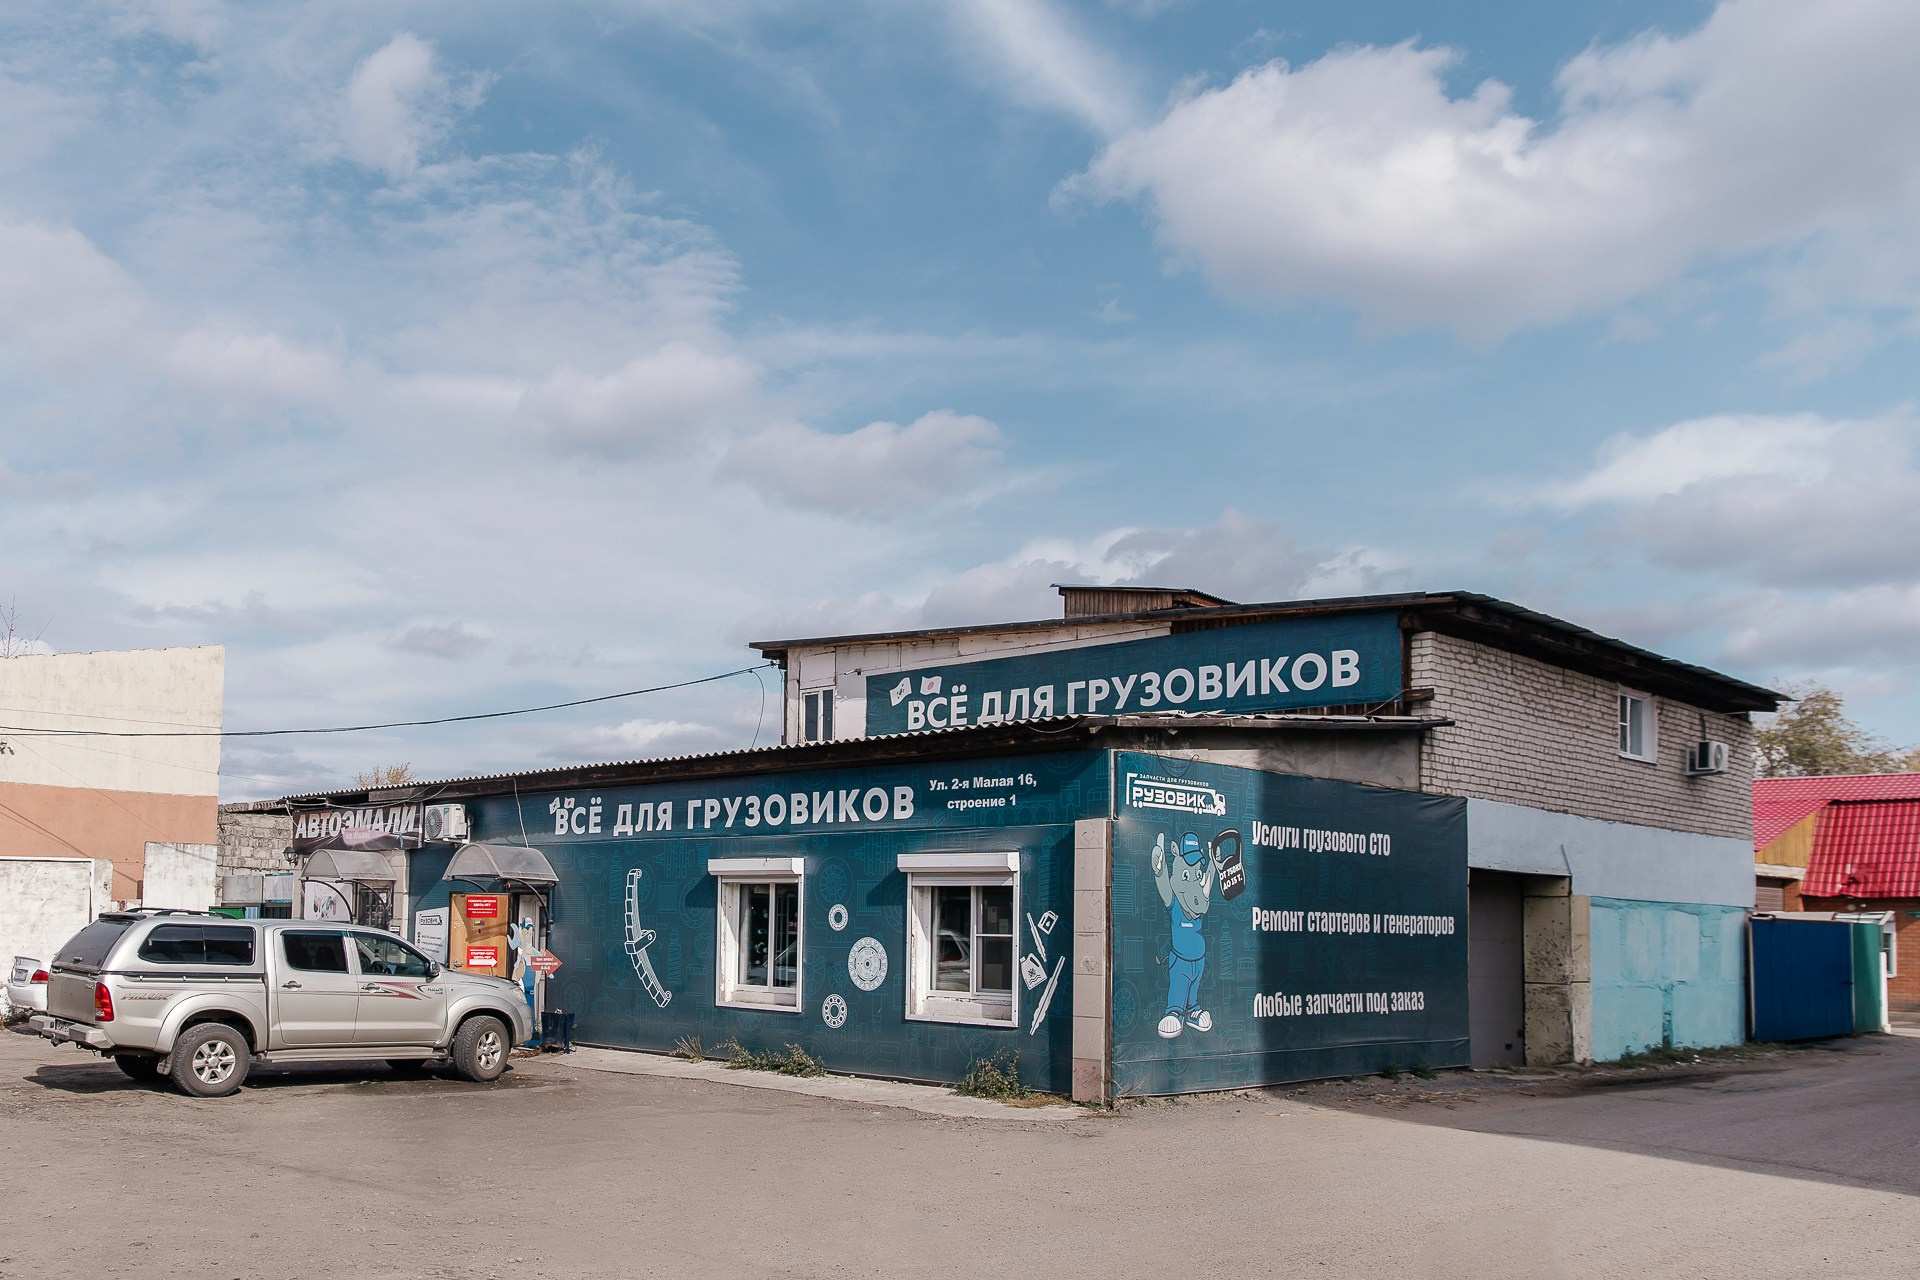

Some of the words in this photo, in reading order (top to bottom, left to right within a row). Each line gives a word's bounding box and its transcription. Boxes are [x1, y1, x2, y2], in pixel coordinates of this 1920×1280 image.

[907, 684, 968, 731] ВСЁ
[976, 684, 1054, 726] ДЛЯ
[1067, 649, 1360, 715] ГРУЗОВИКОВ
[929, 780, 948, 791] Ул.
[951, 778, 970, 790] 2-я
[973, 776, 1014, 789] Малая
[1017, 773, 1037, 788] 16,
[1139, 773, 1166, 782] ЗАПЧАСТИ
[1178, 778, 1210, 788] ГРУЗОВИКОВ
[555, 797, 602, 835] ВСЁ
[613, 802, 672, 836] ДЛЯ
[687, 786, 915, 830] ГРУЗОВИКОВ
[947, 797, 1006, 811] строение
[1009, 794, 1017, 806] 1
[295, 805, 417, 839] АВТОЭМАЛИ
[1252, 820, 1300, 850] Услуги
[1303, 828, 1366, 853] грузового
[1252, 907, 1304, 932] Ремонт
[1307, 911, 1370, 936] стартеров
[1373, 914, 1381, 934] и
[1383, 914, 1455, 937] генераторов
[1253, 992, 1302, 1018] Любые
[1306, 993, 1363, 1015] запчасти
[1366, 992, 1389, 1014] под
[1391, 991, 1424, 1011] заказ
